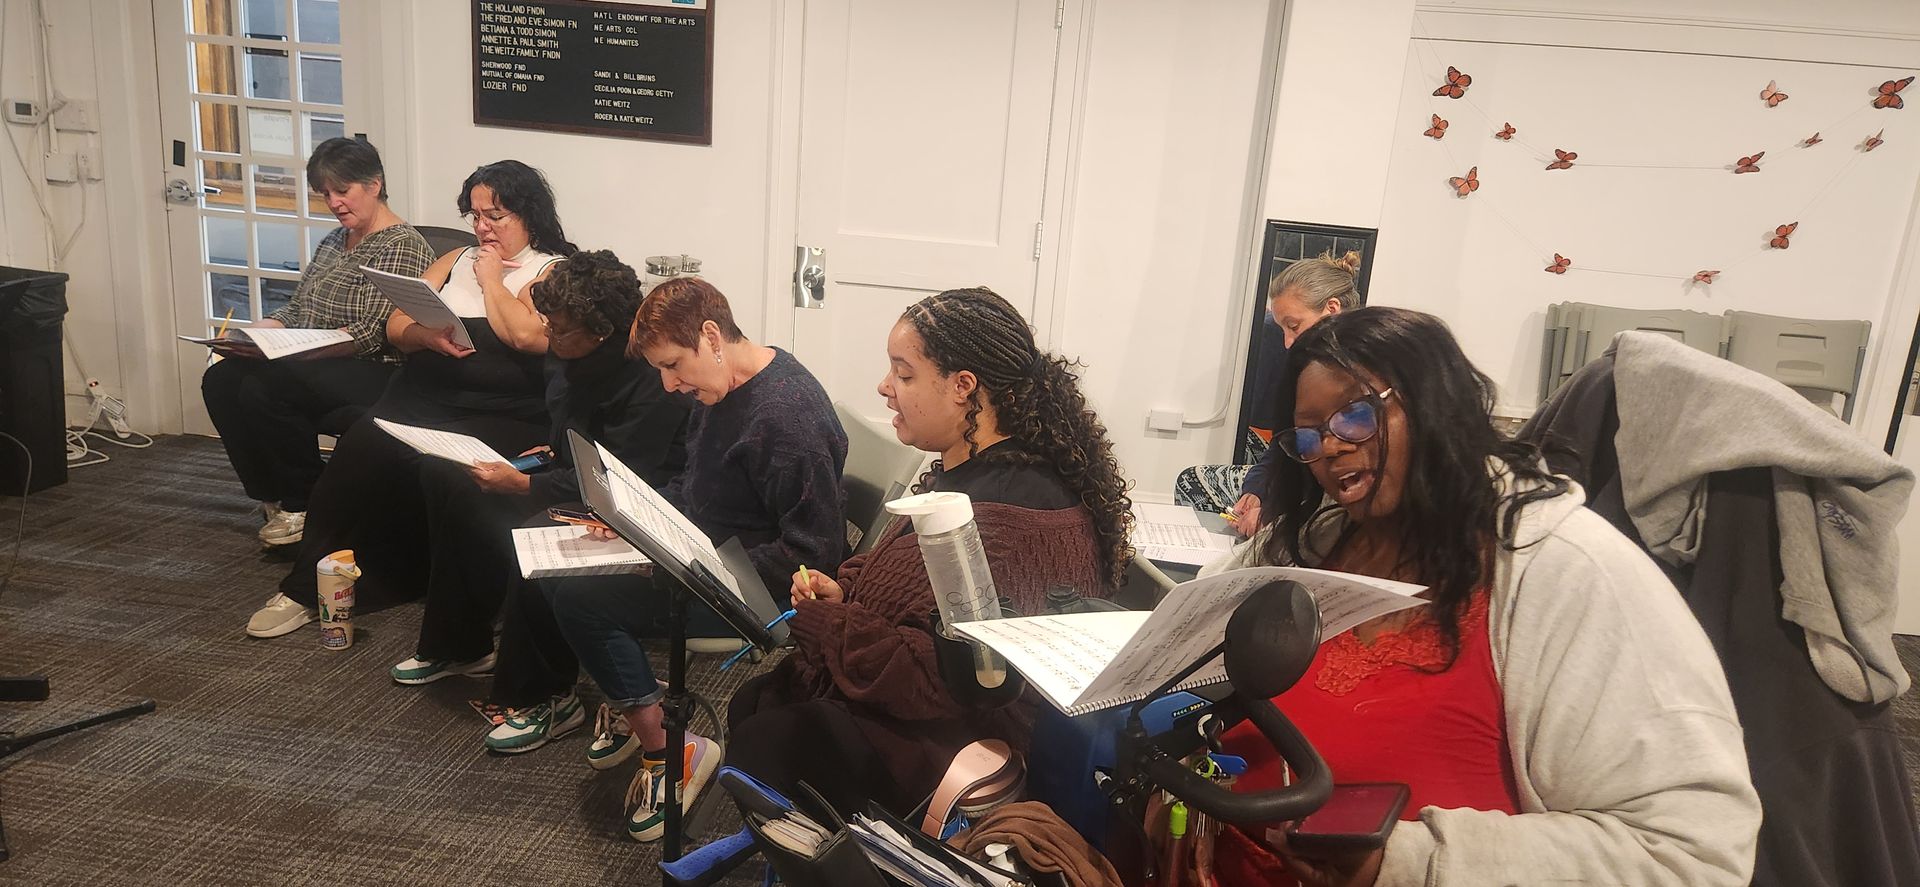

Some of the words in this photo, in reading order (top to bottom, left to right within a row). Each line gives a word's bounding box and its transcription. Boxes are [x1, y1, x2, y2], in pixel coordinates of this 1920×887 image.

[480, 2, 494, 12] THE
[495, 4, 525, 14] HOLLAND
[526, 6, 545, 16] FNDN
[480, 13, 494, 22] THE
[495, 14, 512, 24] FRED
[514, 16, 527, 24] AND
[528, 17, 542, 26] EVE
[544, 18, 565, 28] SIMON
[568, 20, 578, 29] FN
[678, 18, 696, 26] ARTS
[480, 24, 509, 34] BETIANA
[510, 26, 516, 34] &
[516, 27, 534, 36] TODD
[534, 28, 556, 38] SIMON
[480, 34, 512, 45] ANNETTE
[513, 38, 518, 46] &
[520, 38, 536, 47] PAUL
[537, 40, 558, 48] SMITH
[606, 38, 640, 46] HUMANITES
[516, 48, 540, 58] FAMILY
[542, 50, 560, 60] FNDN
[482, 61, 512, 70] SHERWOOD
[482, 70, 504, 78] MUTUAL
[594, 70, 612, 78] SANDI
[624, 72, 636, 80] BILL
[636, 74, 656, 82] BRUNS
[482, 80, 508, 90] LOZIER
[512, 82, 528, 92] FND
[594, 84, 616, 92] CECILIA
[616, 86, 632, 94] POON
[656, 90, 674, 98] GETTY
[594, 98, 612, 106] KATIE
[612, 100, 630, 108] WEITZ
[594, 113, 614, 121] ROGER
[620, 115, 634, 123] KATE
[635, 116, 654, 124] WEITZ
